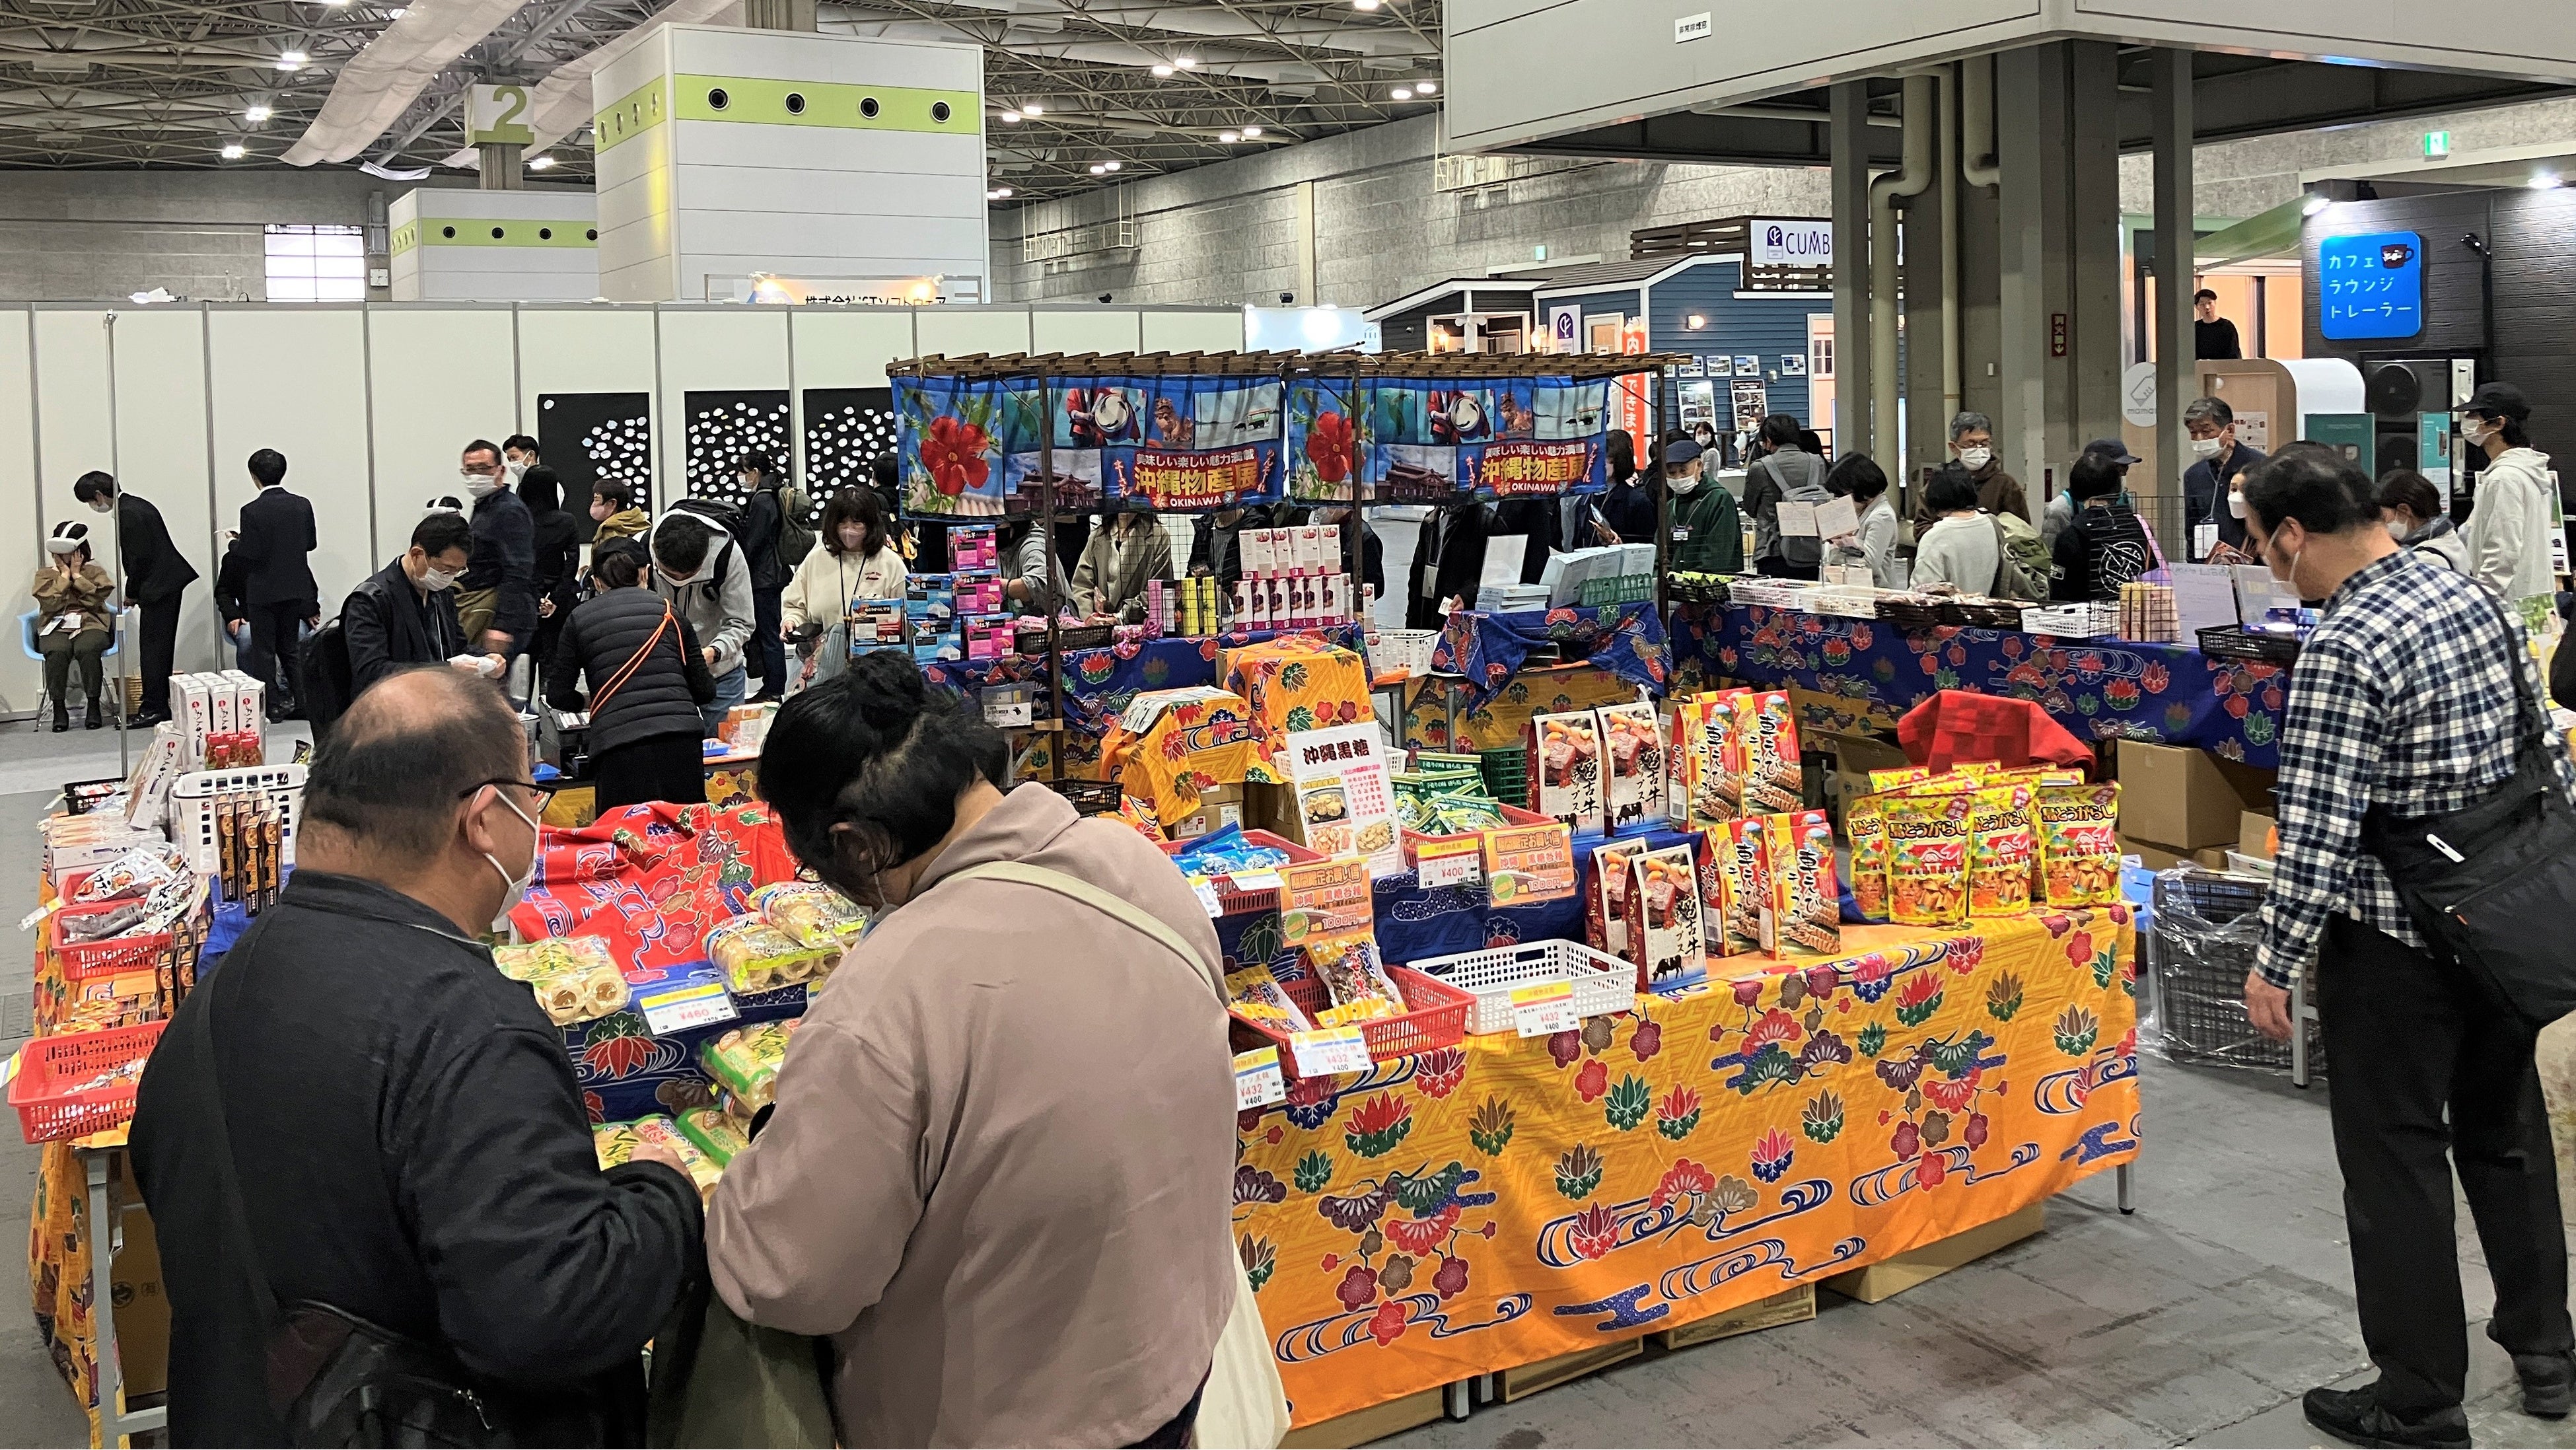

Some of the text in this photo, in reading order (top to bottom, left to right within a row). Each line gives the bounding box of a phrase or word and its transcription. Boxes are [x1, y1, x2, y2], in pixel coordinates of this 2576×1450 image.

[492, 85, 530, 132] 2
[1786, 231, 1830, 255] CUMB
[2329, 255, 2375, 270] カフェ
[2329, 277, 2394, 295] ラウンジ
[2331, 302, 2413, 319] トレーラー
[1479, 455, 1586, 484] 沖縄物産展
[1133, 463, 1258, 496] 沖縄物産展
[1511, 482, 1556, 492] OKINAWA
[1170, 495, 1222, 507] OKINAWA
[1303, 739, 1370, 765] 沖縄黒糖
[1636, 747, 1664, 808] 宮古牛 チップス
[1571, 771, 1580, 811] チップス
[1581, 756, 1600, 820] 宮古牛
[2041, 804, 2114, 822] 島とうがらし
[1851, 818, 1880, 836] 島とう
[1887, 820, 1968, 840] 島とうがらし
[1499, 855, 1520, 869] 沖縄
[1441, 867, 1463, 878] ¥400
[1528, 879, 1562, 892] 1000円
[1294, 892, 1314, 908] 沖縄
[1322, 913, 1358, 929] 1000円
[1681, 894, 1701, 960] 宮古牛
[1540, 1011, 1559, 1023] ¥432
[1545, 1022, 1559, 1031] ¥400
[1326, 1054, 1349, 1064] ¥432
[1240, 1083, 1263, 1097] ¥432
[1245, 1095, 1262, 1105] ¥400
